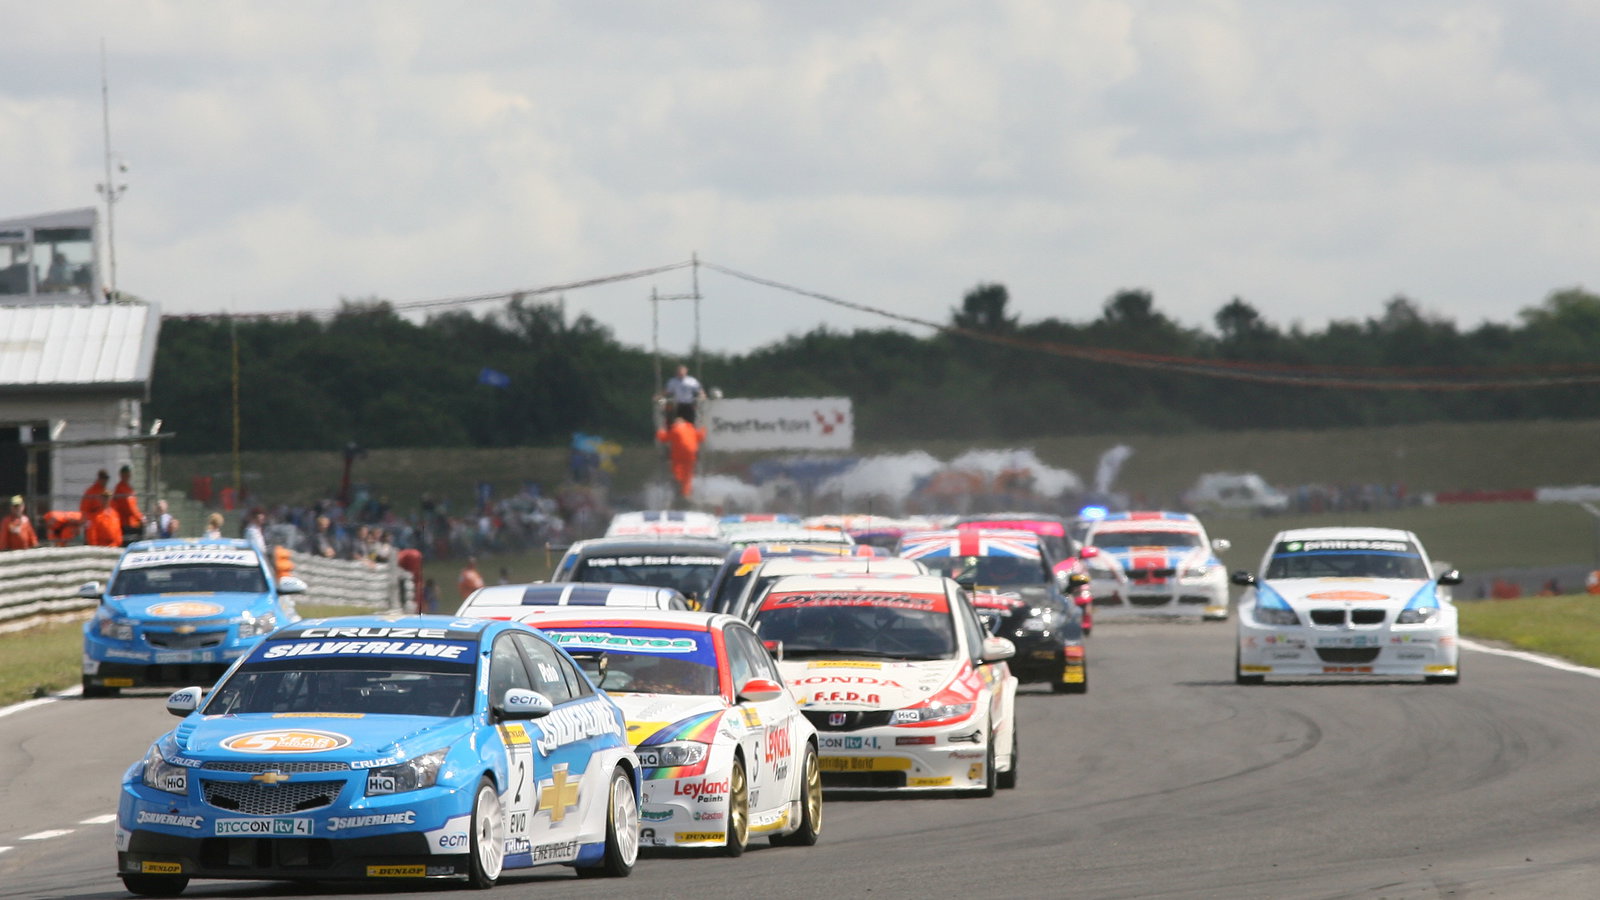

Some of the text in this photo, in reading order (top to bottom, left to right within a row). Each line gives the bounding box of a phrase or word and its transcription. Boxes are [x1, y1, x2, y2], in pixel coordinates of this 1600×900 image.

[300, 627, 449, 639] CRUZE
[263, 641, 468, 659] SILVERLINE
[169, 693, 192, 703] ecm
[510, 695, 542, 706] ecm
[898, 712, 918, 720] HiQ
[169, 757, 202, 768] CRUZE
[351, 757, 397, 769] CRUZE
[167, 778, 185, 789] HiQ
[369, 778, 393, 790] HiQ
[514, 760, 525, 805] 2
[674, 777, 728, 799] Leyland
[698, 795, 724, 803] Paints
[143, 812, 193, 828] SILVERLINE
[274, 818, 293, 833] itv
[296, 821, 305, 832] 4
[339, 812, 405, 829] SILVERLINE
[510, 813, 526, 833] evo
[439, 834, 468, 847] ecm
[533, 840, 578, 861] CHEVROLET
[379, 866, 424, 875] DUNLOP
